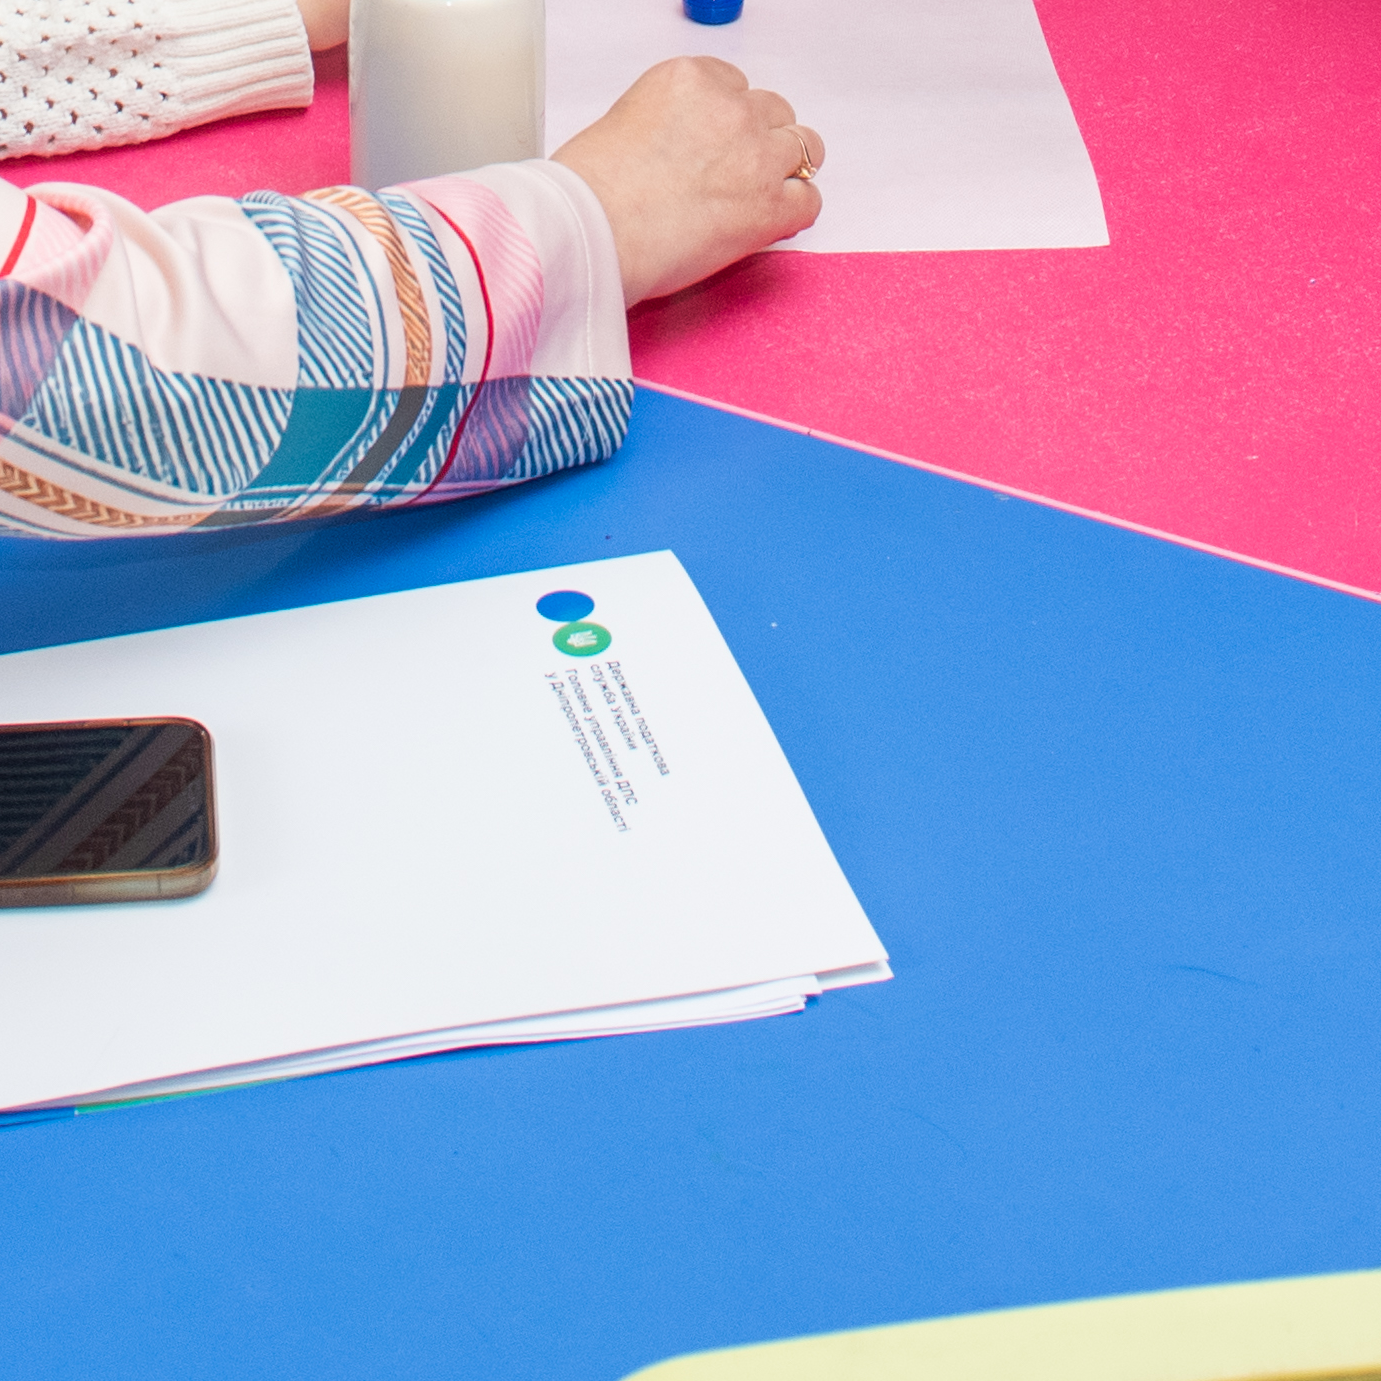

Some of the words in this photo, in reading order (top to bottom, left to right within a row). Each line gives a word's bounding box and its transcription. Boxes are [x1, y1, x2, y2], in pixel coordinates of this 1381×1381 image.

[550, 682, 610, 787] Дніпропетровській
[601, 788, 631, 832] області
[565, 668, 593, 713] Головне
[586, 715, 623, 779] управління
[615, 779, 638, 806] ДПС
[590, 663, 616, 705] служба
[611, 706, 638, 751] України
[605, 660, 641, 716] Державна
[635, 716, 670, 777] податкова
